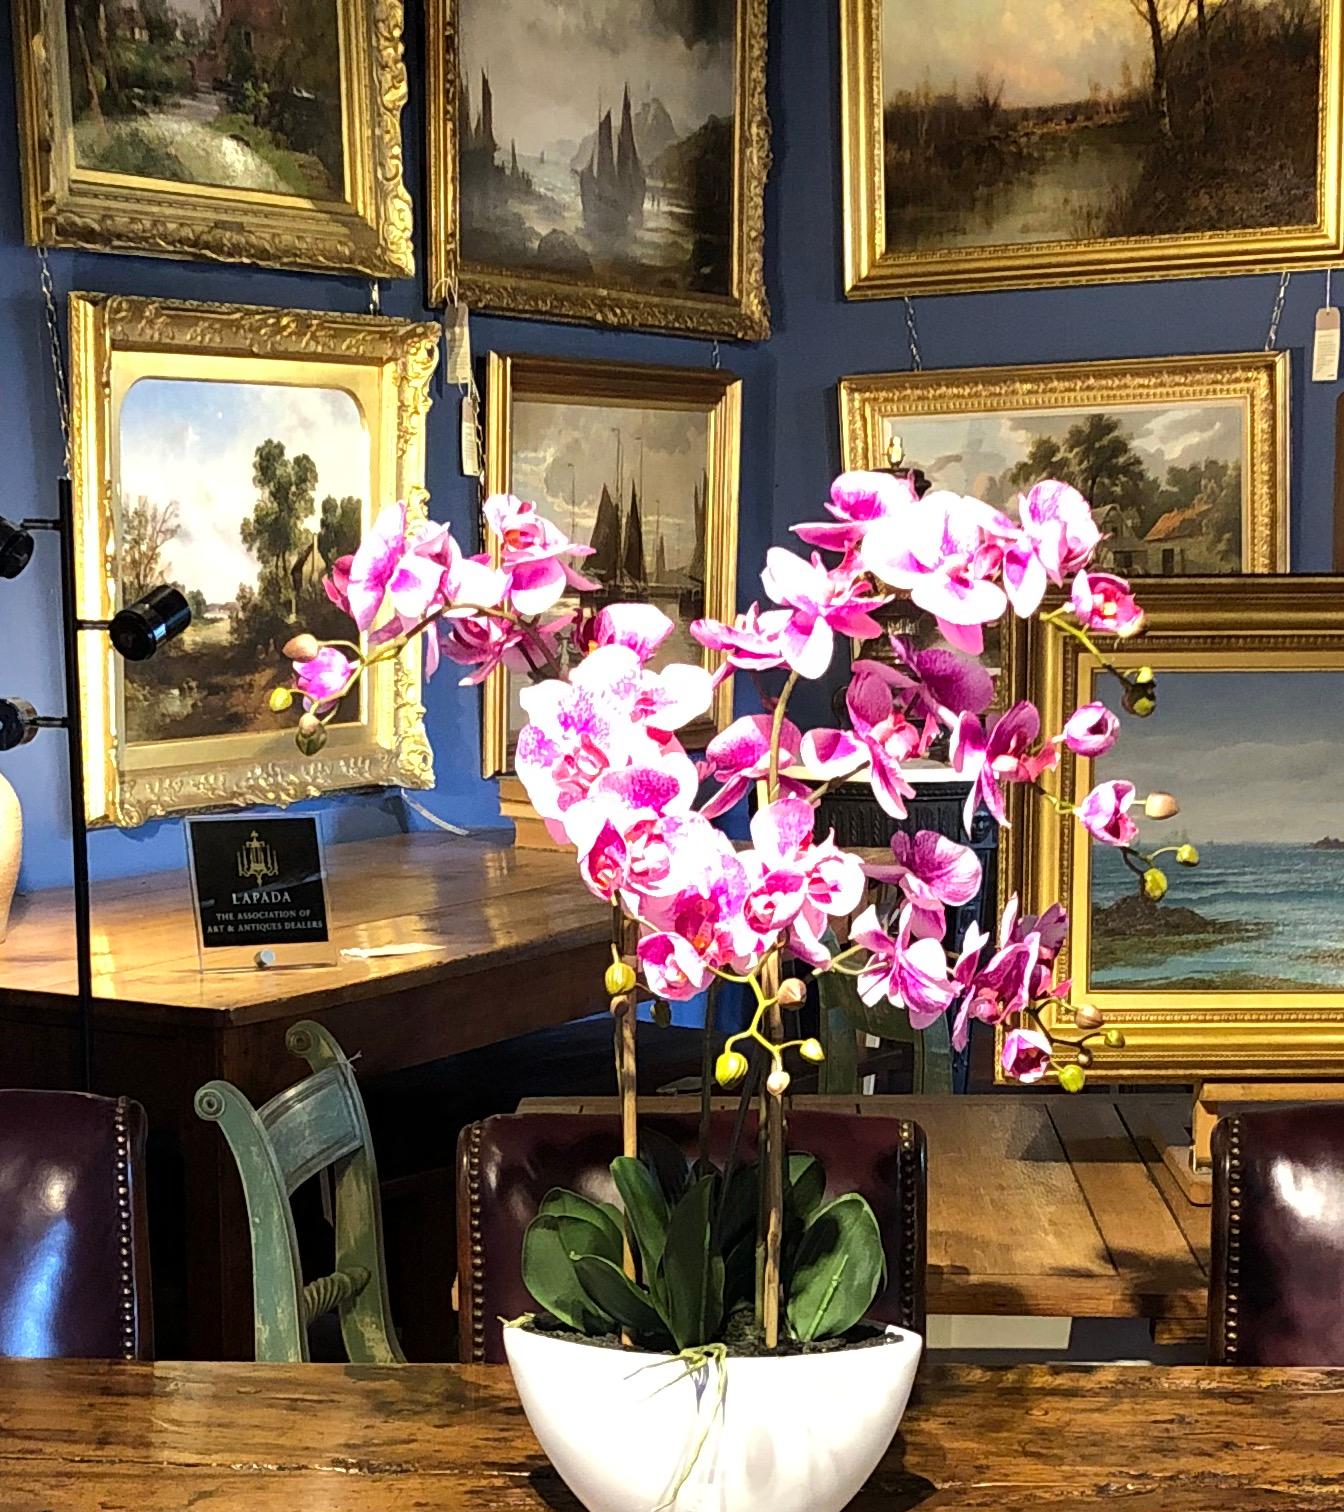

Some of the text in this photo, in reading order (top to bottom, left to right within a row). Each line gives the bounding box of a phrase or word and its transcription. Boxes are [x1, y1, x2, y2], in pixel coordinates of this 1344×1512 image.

[231, 891, 292, 904] LAPADA
[215, 909, 311, 921] THE ASSOCIATION OF
[206, 919, 323, 934] ART & ANTIQUES DEALERS
